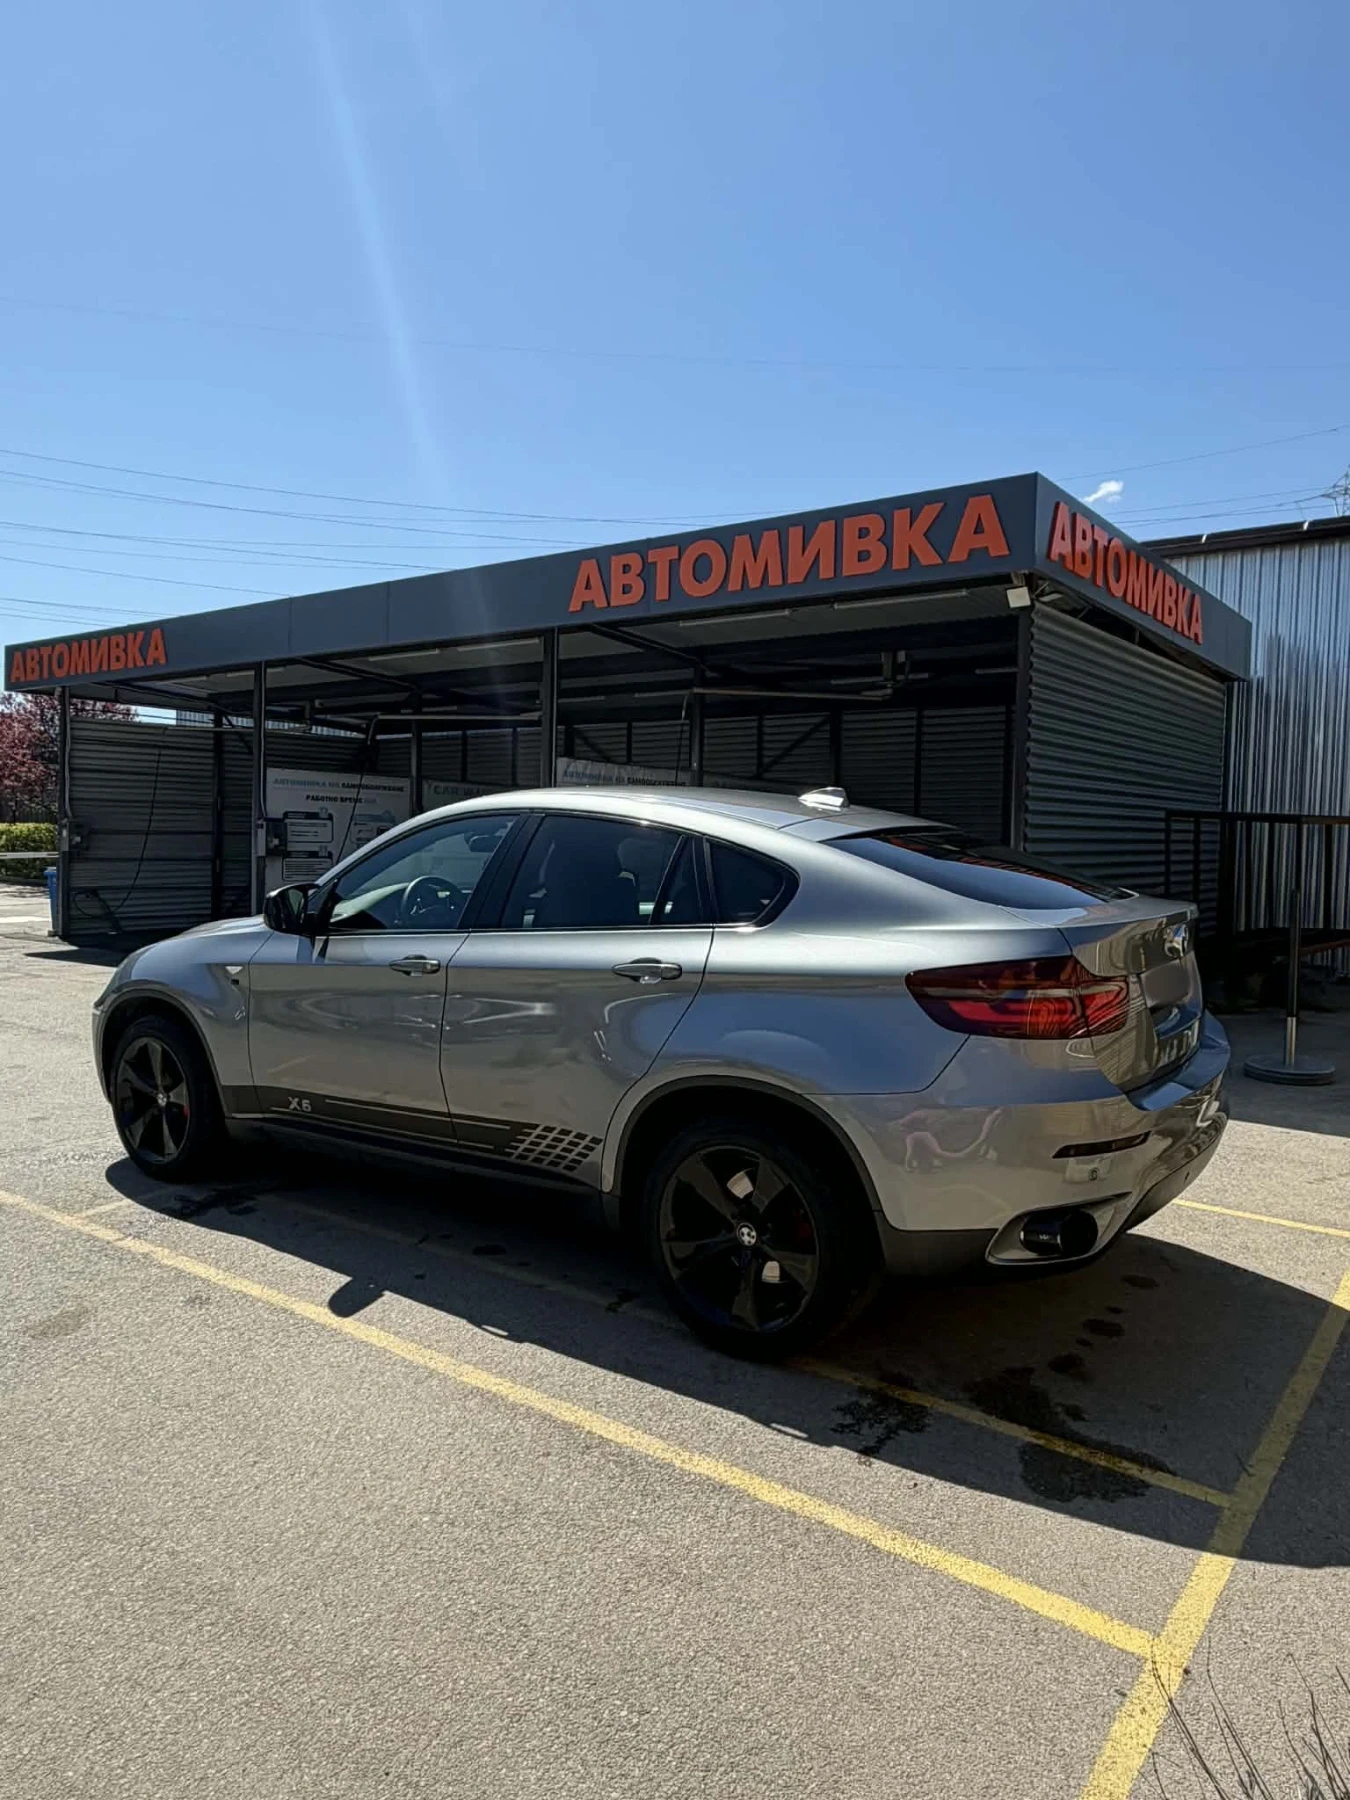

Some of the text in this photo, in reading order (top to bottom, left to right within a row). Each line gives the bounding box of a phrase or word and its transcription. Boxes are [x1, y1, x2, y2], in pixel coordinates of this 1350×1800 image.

[569, 496, 1009, 612] АВТОМИВКА
[1049, 502, 1203, 644] АВТОМИВКА
[10, 628, 167, 683] АВТОМИВКА
[288, 1096, 312, 1112] X6
